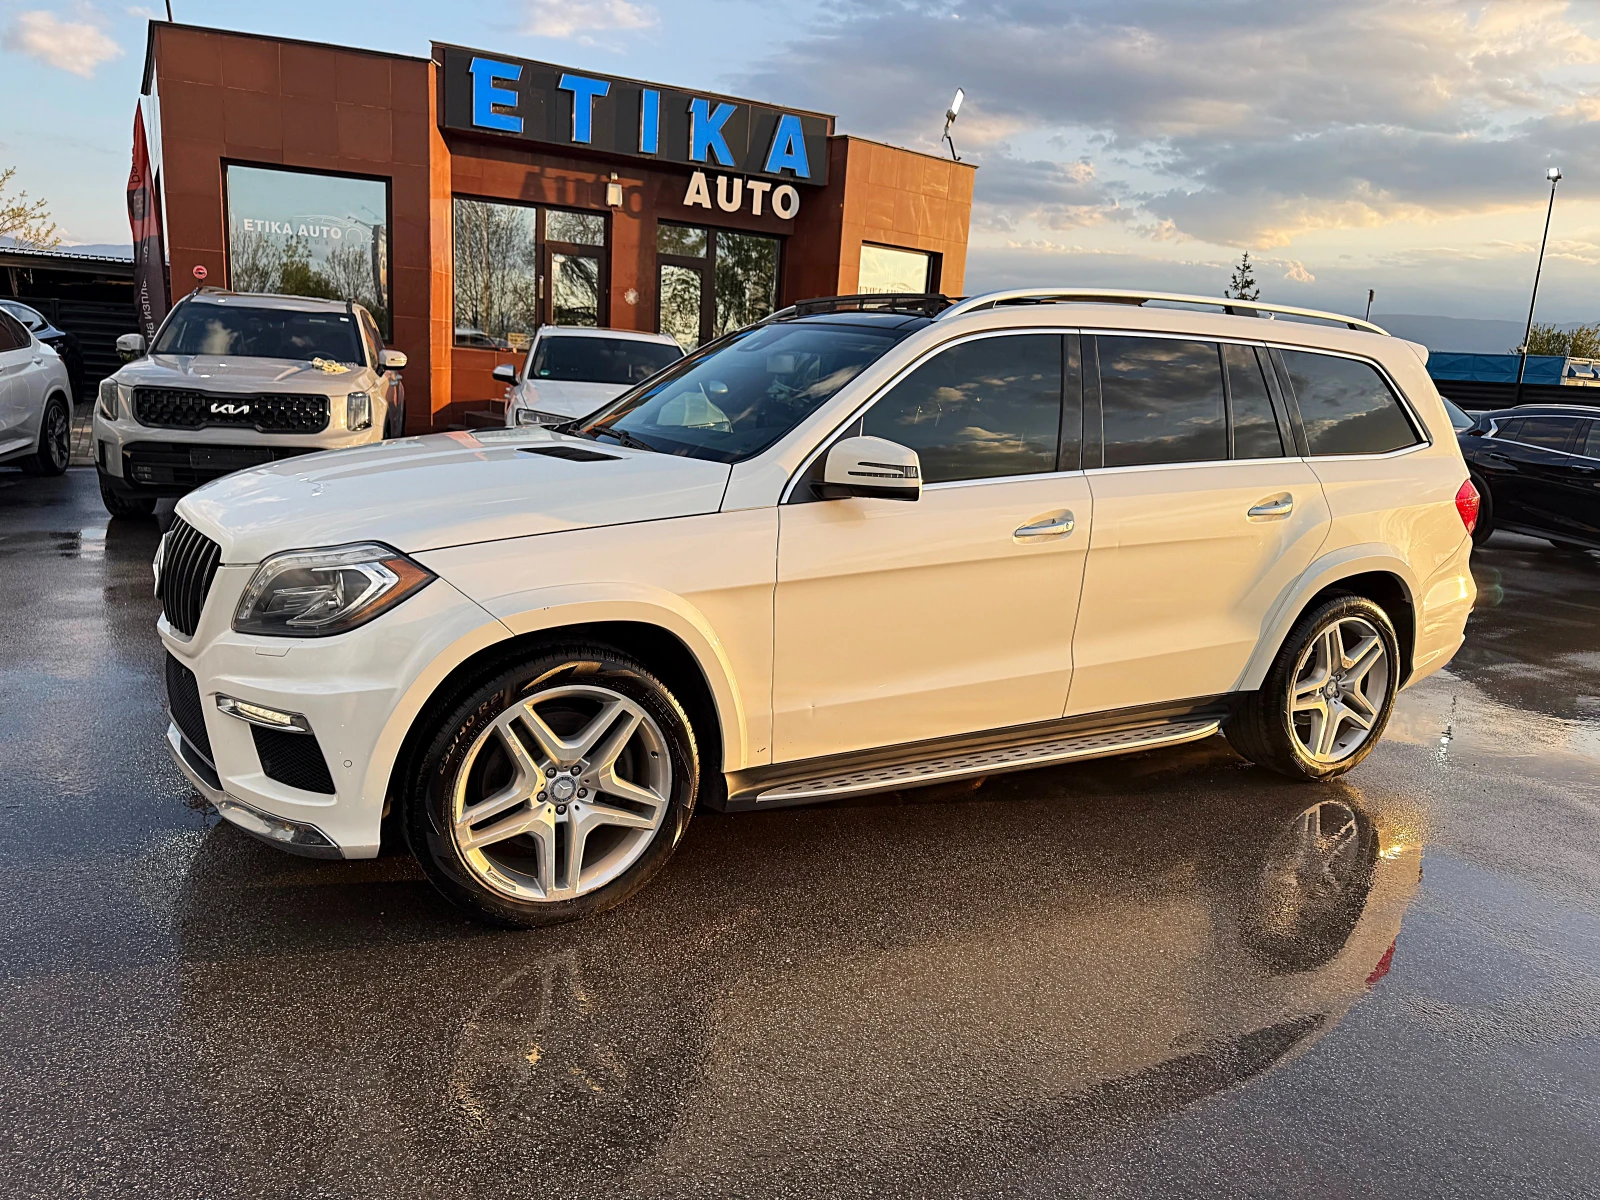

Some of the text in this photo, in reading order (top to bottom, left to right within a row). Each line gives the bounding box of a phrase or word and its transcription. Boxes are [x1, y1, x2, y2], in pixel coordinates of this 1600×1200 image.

[469, 56, 812, 179] ETIKA
[682, 171, 800, 220] AUTO
[243, 218, 293, 236] ETIKA
[297, 223, 342, 240] AUTO
[210, 403, 250, 415] KIA
